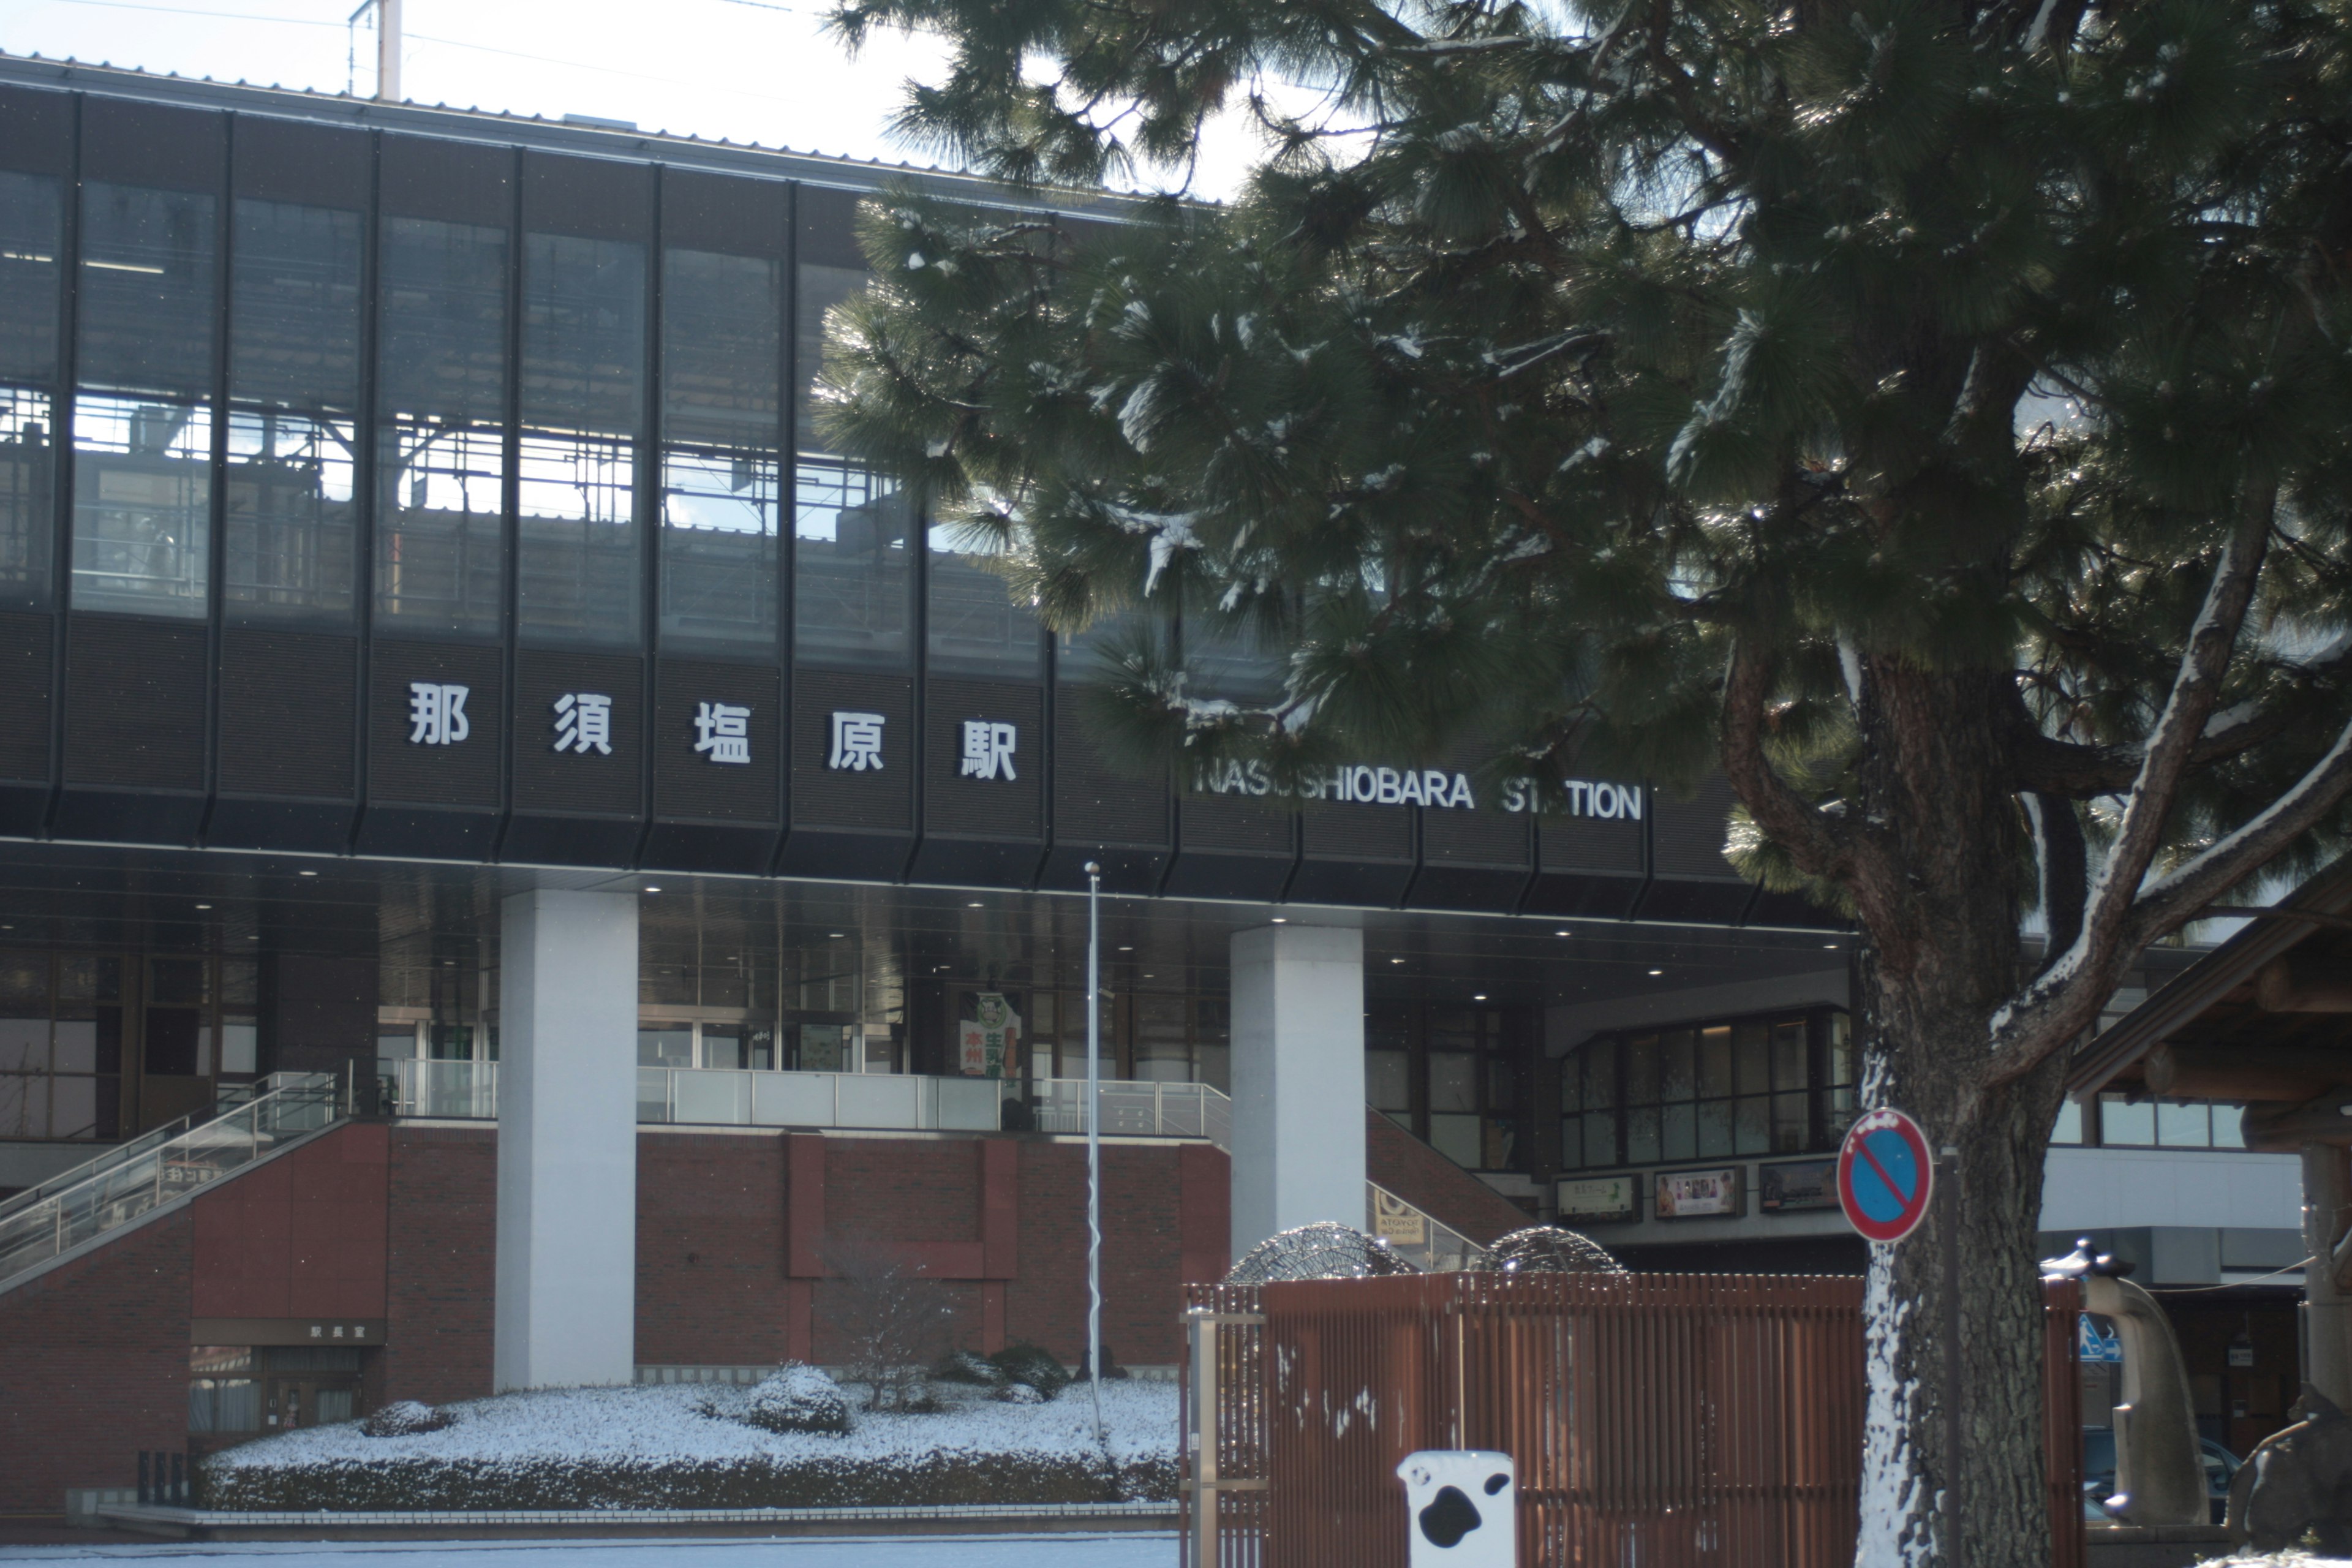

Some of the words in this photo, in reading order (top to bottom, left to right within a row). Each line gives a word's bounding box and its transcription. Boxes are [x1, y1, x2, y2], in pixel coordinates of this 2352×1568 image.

[409, 682, 1017, 782] 那須塩原駅
[1195, 757, 1475, 809] NASSHIOBARA
[1501, 777, 1642, 820] STTION
[310, 1325, 366, 1338] 駅長室
